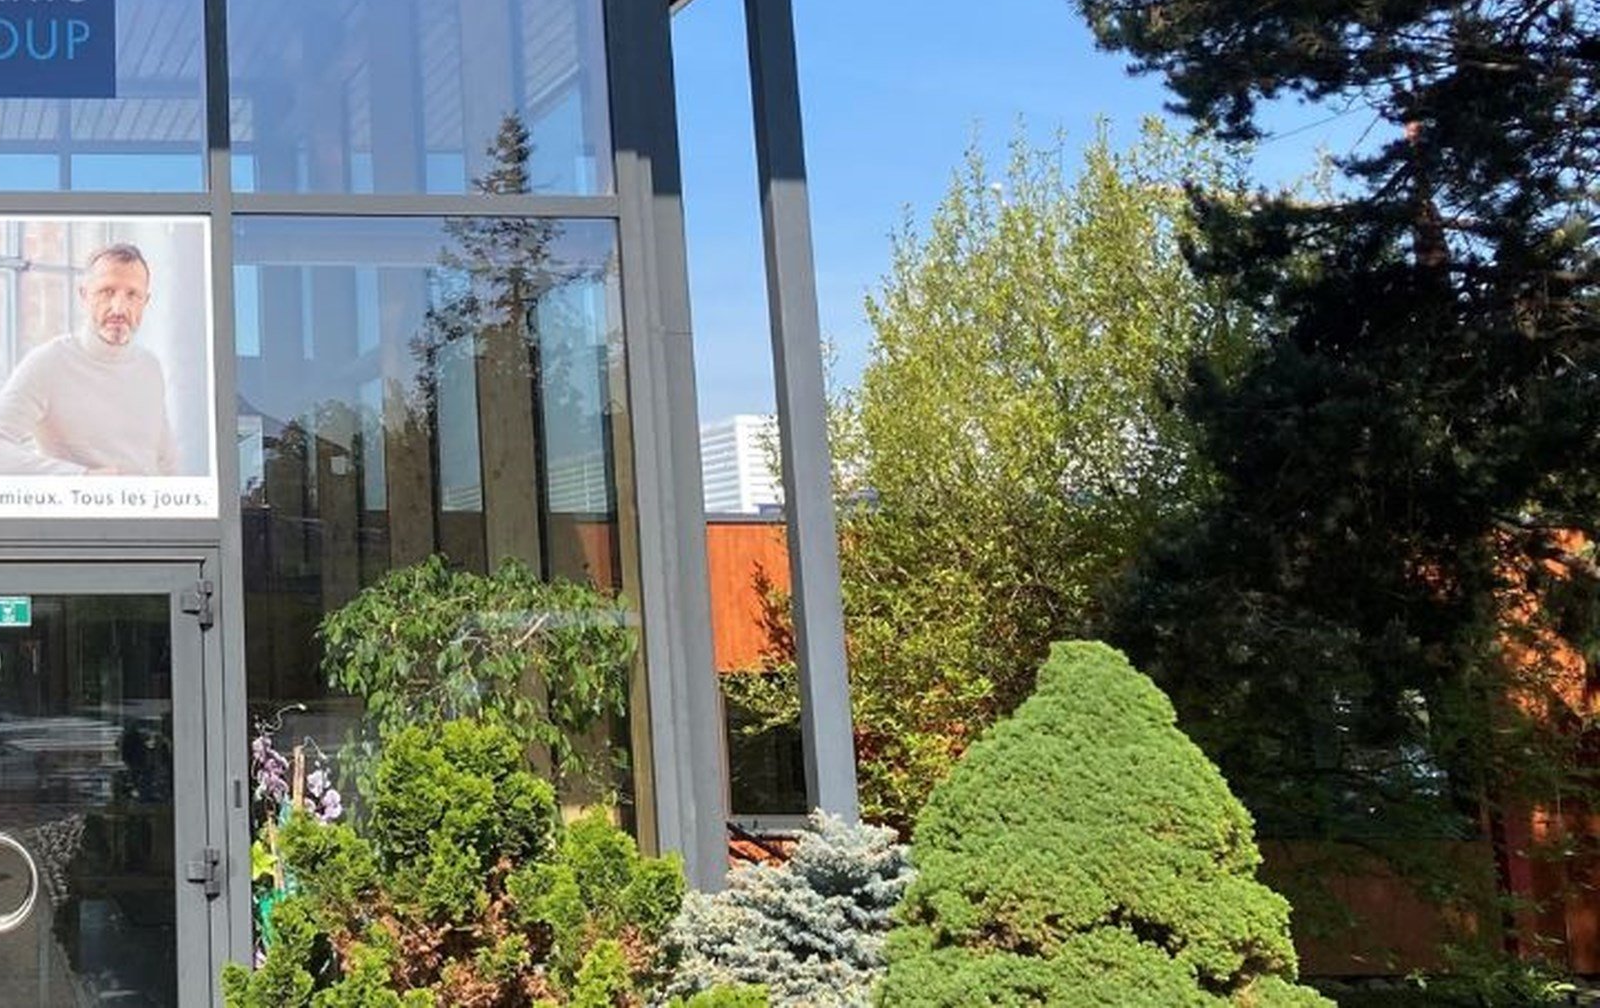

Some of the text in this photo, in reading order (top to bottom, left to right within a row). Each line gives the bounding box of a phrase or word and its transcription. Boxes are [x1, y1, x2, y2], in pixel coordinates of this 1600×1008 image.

[0, 489, 63, 505] mieux.
[70, 489, 114, 506] Tous
[121, 489, 147, 506] les
[152, 489, 209, 510] jours.
